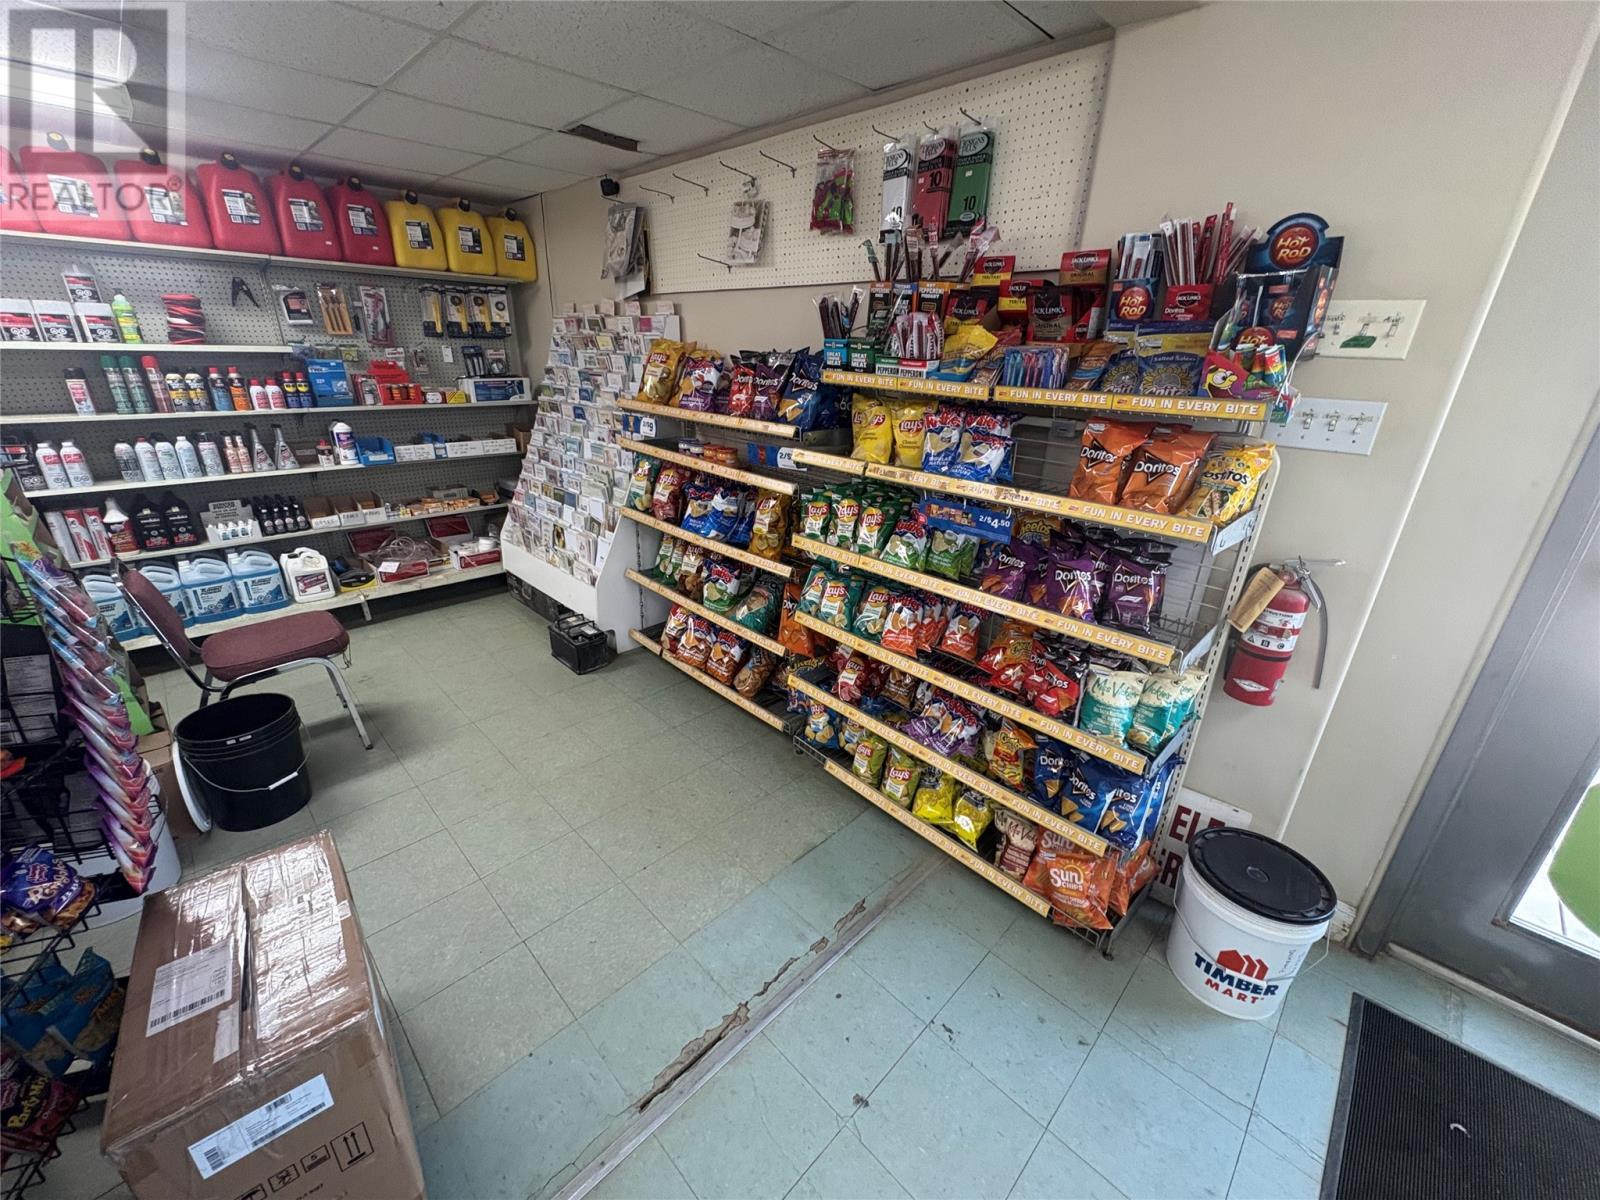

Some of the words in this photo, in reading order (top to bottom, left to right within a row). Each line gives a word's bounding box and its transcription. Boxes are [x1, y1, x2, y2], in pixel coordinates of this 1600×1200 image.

[929, 171, 942, 187] 10
[963, 195, 976, 210] 10
[851, 360, 867, 368] MEAT
[832, 373, 846, 381] FUN
[855, 376, 876, 385] EVERY
[878, 377, 895, 386] BITE
[900, 369, 924, 378] PEPPERONI
[908, 380, 924, 390] FUN
[926, 382, 934, 390] IN
[936, 383, 962, 393] EVERY
[964, 386, 985, 396] BITE
[1010, 391, 1029, 399] FUN
[1032, 391, 1042, 400] IN
[1045, 392, 1078, 403] EVERY
[1082, 394, 1108, 404] BITE
[1131, 398, 1156, 408] FUN
[1160, 399, 1173, 409] IN
[1175, 400, 1219, 413] EVERY
[1225, 404, 1259, 415] BITE
[1080, 445, 1117, 463] Doritos
[1134, 461, 1181, 476] Doritos
[979, 515, 1011, 529] 2/$4.50
[1081, 505, 1106, 517] FUN
[1110, 510, 1123, 520] IN
[1126, 514, 1167, 529] EVERY
[1172, 523, 1205, 537] BITE
[1055, 568, 1092, 582] Doritos
[1114, 572, 1154, 585] Doritos
[953, 588, 971, 599] FUN
[972, 593, 982, 603] IN
[983, 597, 1012, 612] EVERY
[1016, 606, 1039, 620] BITE
[1056, 620, 1080, 632] FUN
[1081, 626, 1094, 637] IN
[1096, 632, 1134, 649] EVERY
[1137, 643, 1168, 659] BITE
[943, 679, 960, 691] FUN
[961, 687, 970, 696] IN
[971, 690, 998, 707] EVERY
[1001, 702, 1022, 718] BITE
[1039, 720, 1060, 734] FUN
[1063, 728, 1073, 739] IN
[1076, 735, 1111, 756] EVERY
[1112, 751, 1141, 769] BITE
[1011, 799, 1028, 813] FUN
[1029, 809, 1041, 821] IN
[1044, 816, 1075, 837] EVERY
[1078, 832, 1101, 853] BITE
[969, 856, 985, 871] FUN
[987, 866, 997, 878] IN
[996, 871, 1023, 895] EVERY
[1024, 890, 1046, 914] BITE
[1194, 951, 1279, 996] TIMBER
[1204, 977, 1260, 1004] MART
